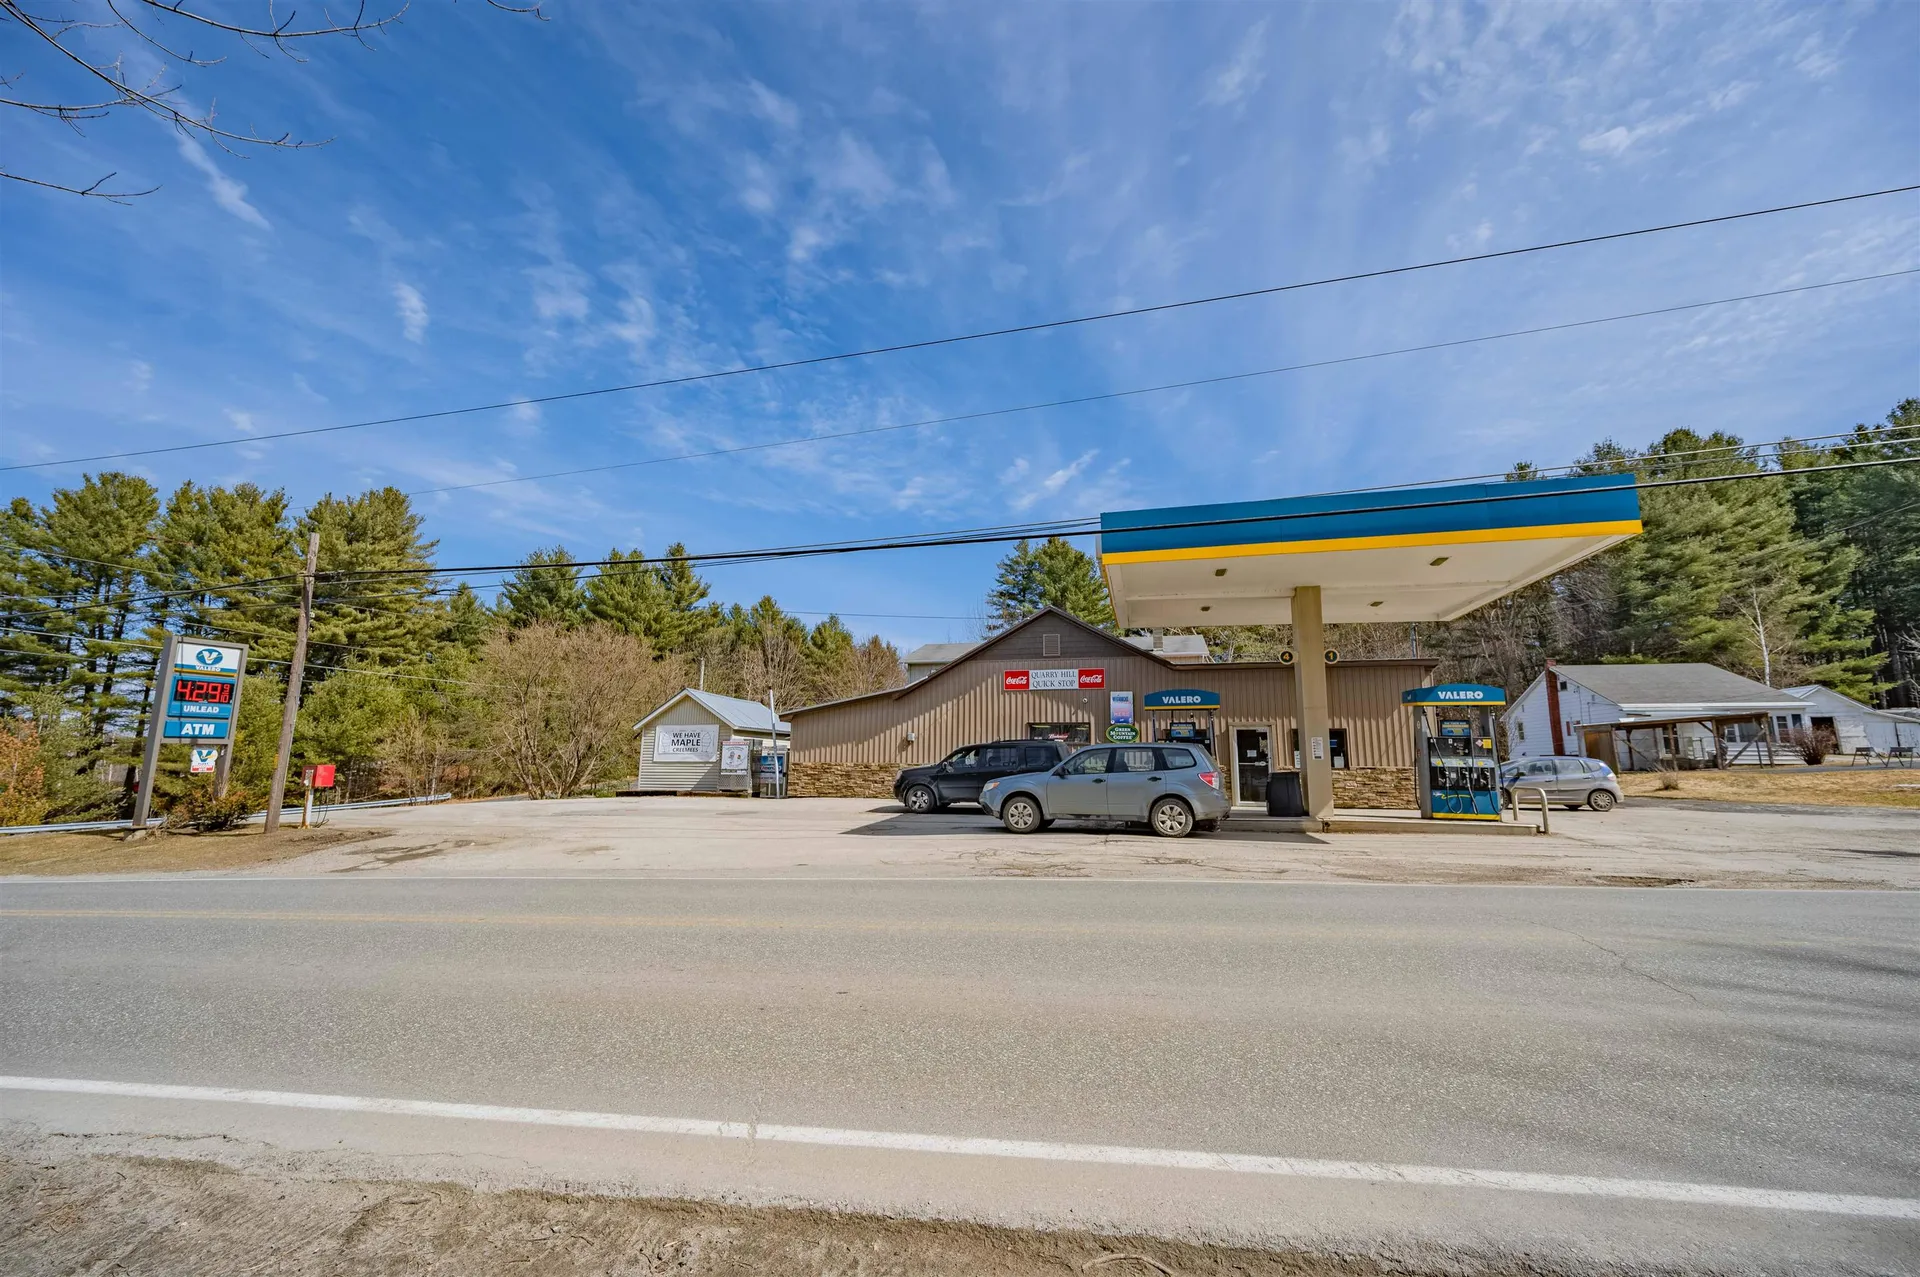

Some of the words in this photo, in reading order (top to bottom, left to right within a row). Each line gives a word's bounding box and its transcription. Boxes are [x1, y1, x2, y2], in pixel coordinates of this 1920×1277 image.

[195, 664, 221, 672] VALERO
[1031, 671, 1058, 679] QUARRY
[1079, 674, 1103, 684] Coca-Cola
[1005, 676, 1027, 685] Coca-Cola
[1032, 680, 1056, 688] QUICK
[1057, 679, 1076, 687] STOP
[177, 680, 222, 703] 4.29
[1438, 690, 1484, 700] VALERO
[1162, 695, 1201, 704] VALERO
[183, 705, 220, 713] UNLEAD
[180, 723, 215, 735] ATM
